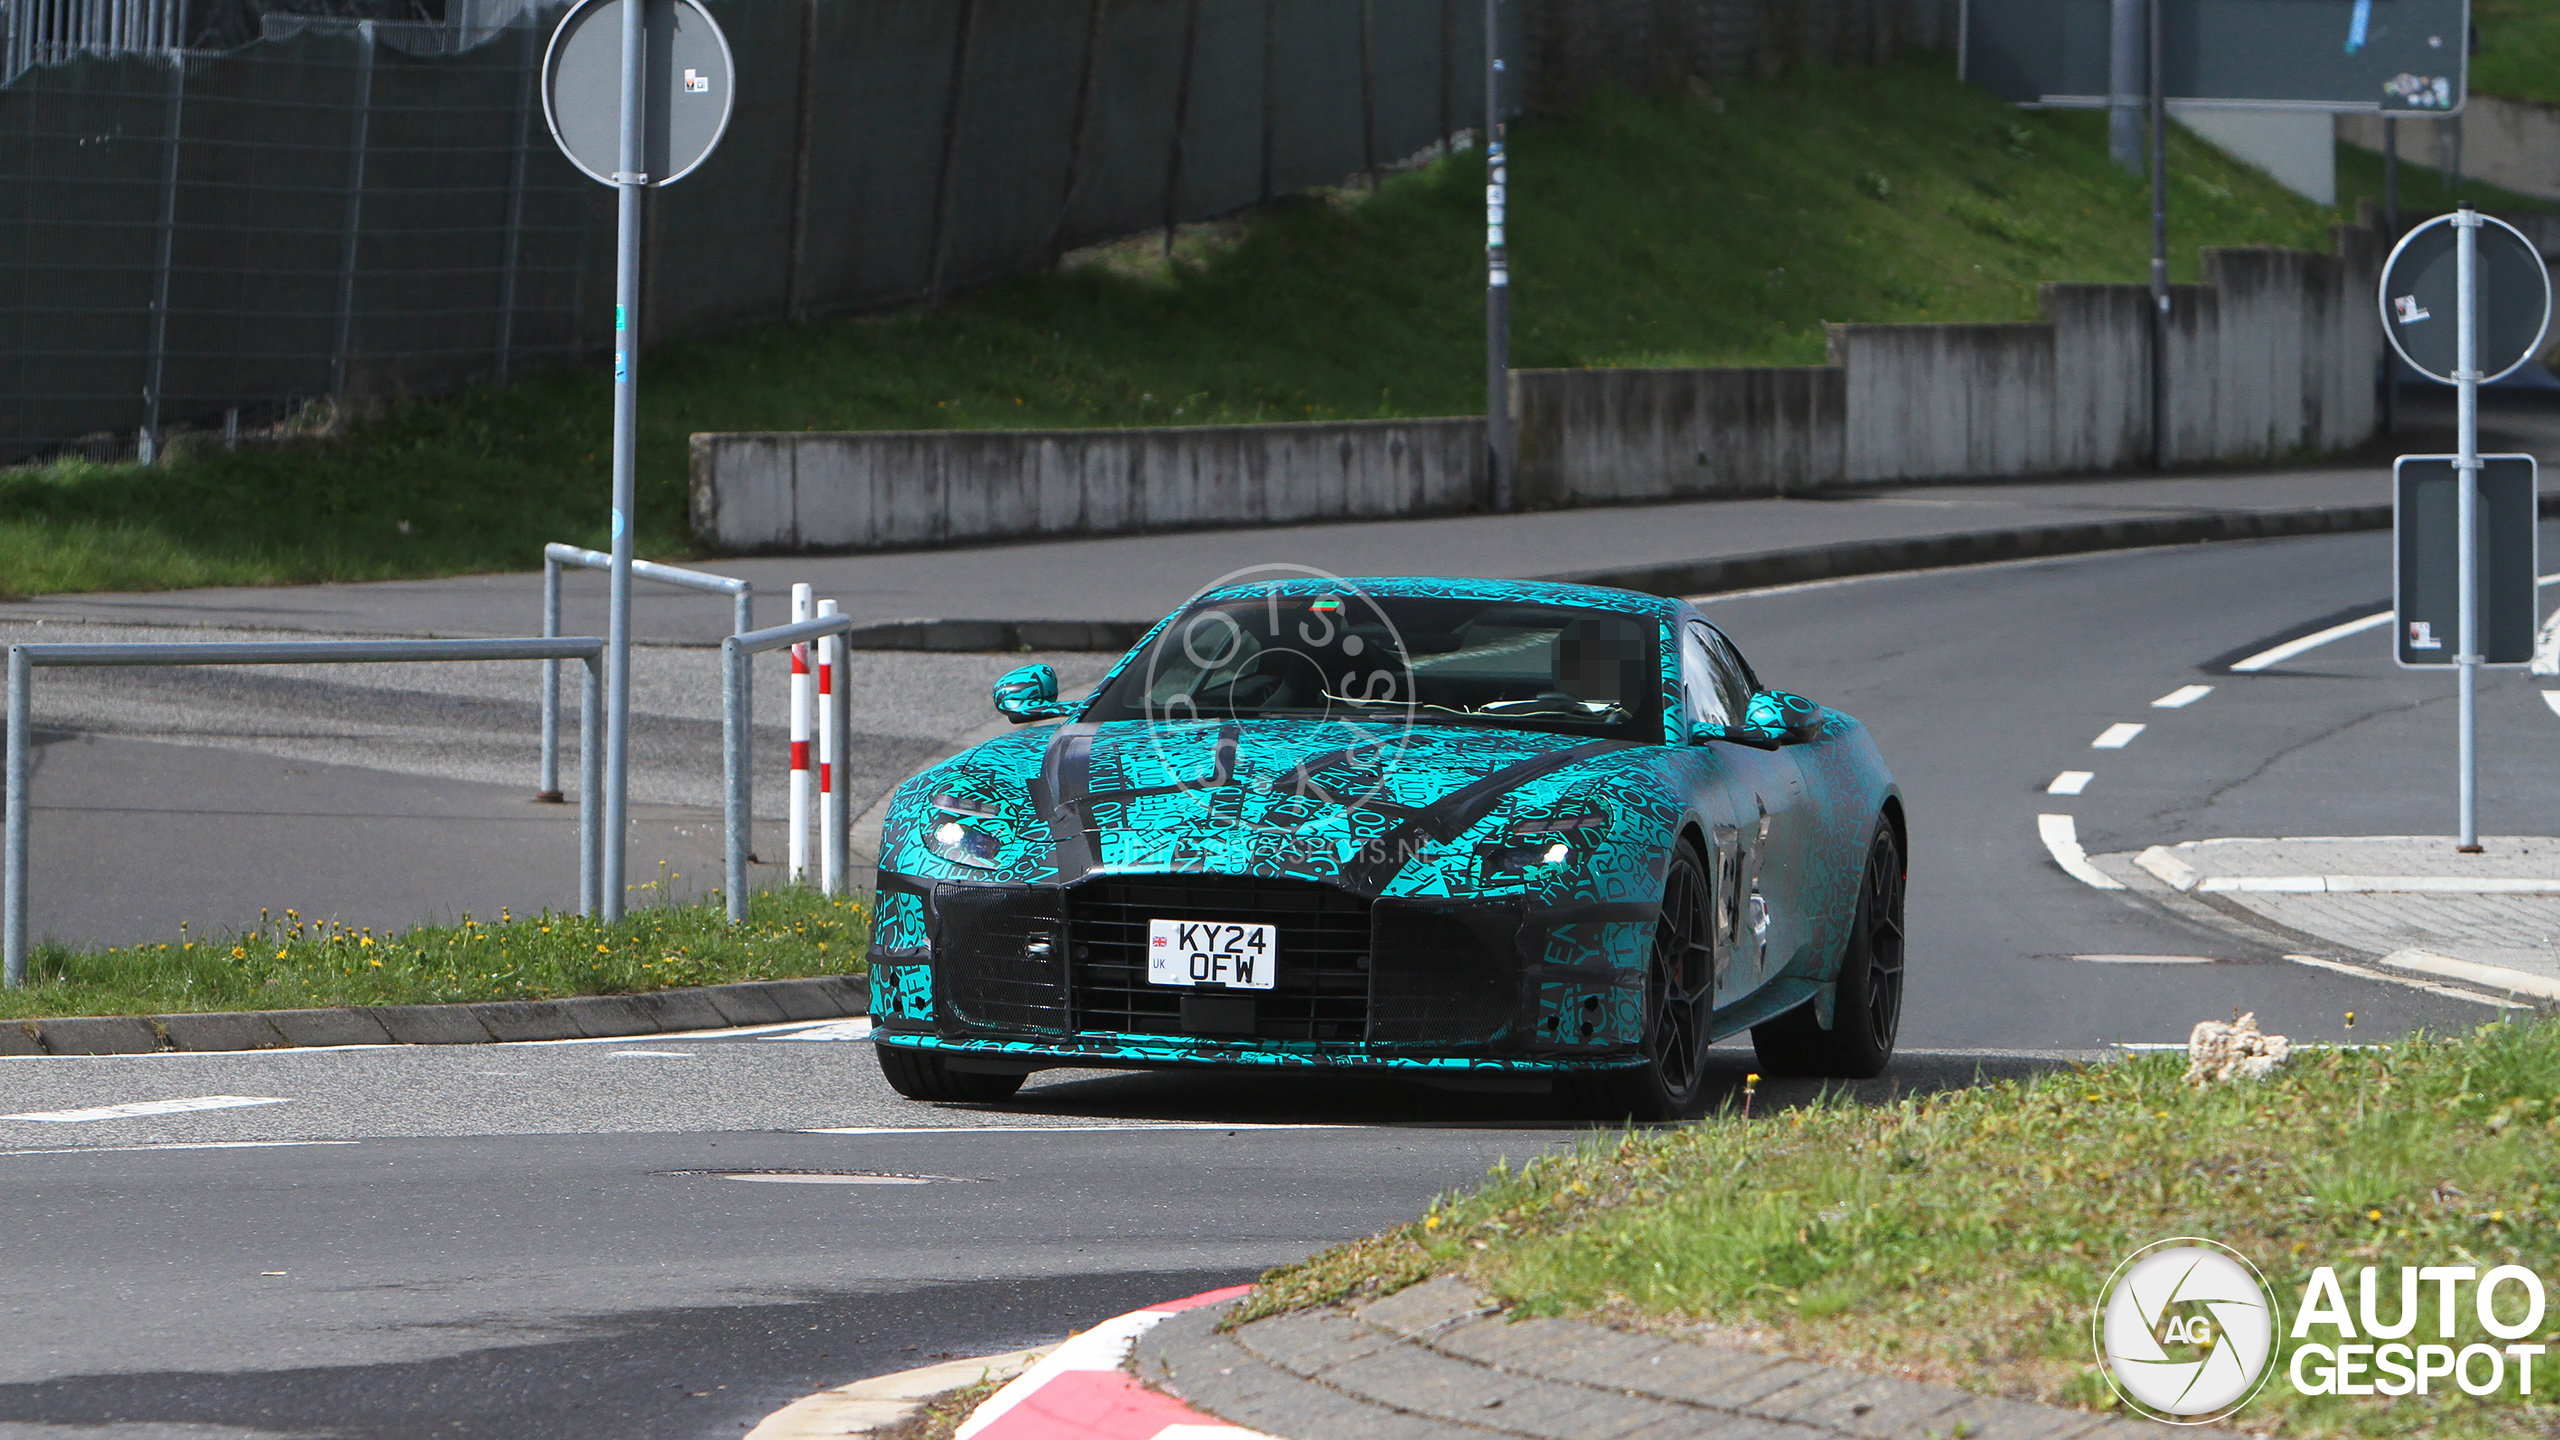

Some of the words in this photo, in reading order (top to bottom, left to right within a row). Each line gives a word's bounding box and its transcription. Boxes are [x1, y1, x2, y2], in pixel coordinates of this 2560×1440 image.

[1179, 923, 1267, 955] KY24
[1152, 958, 1166, 970] UK
[1189, 952, 1255, 984] OFW
